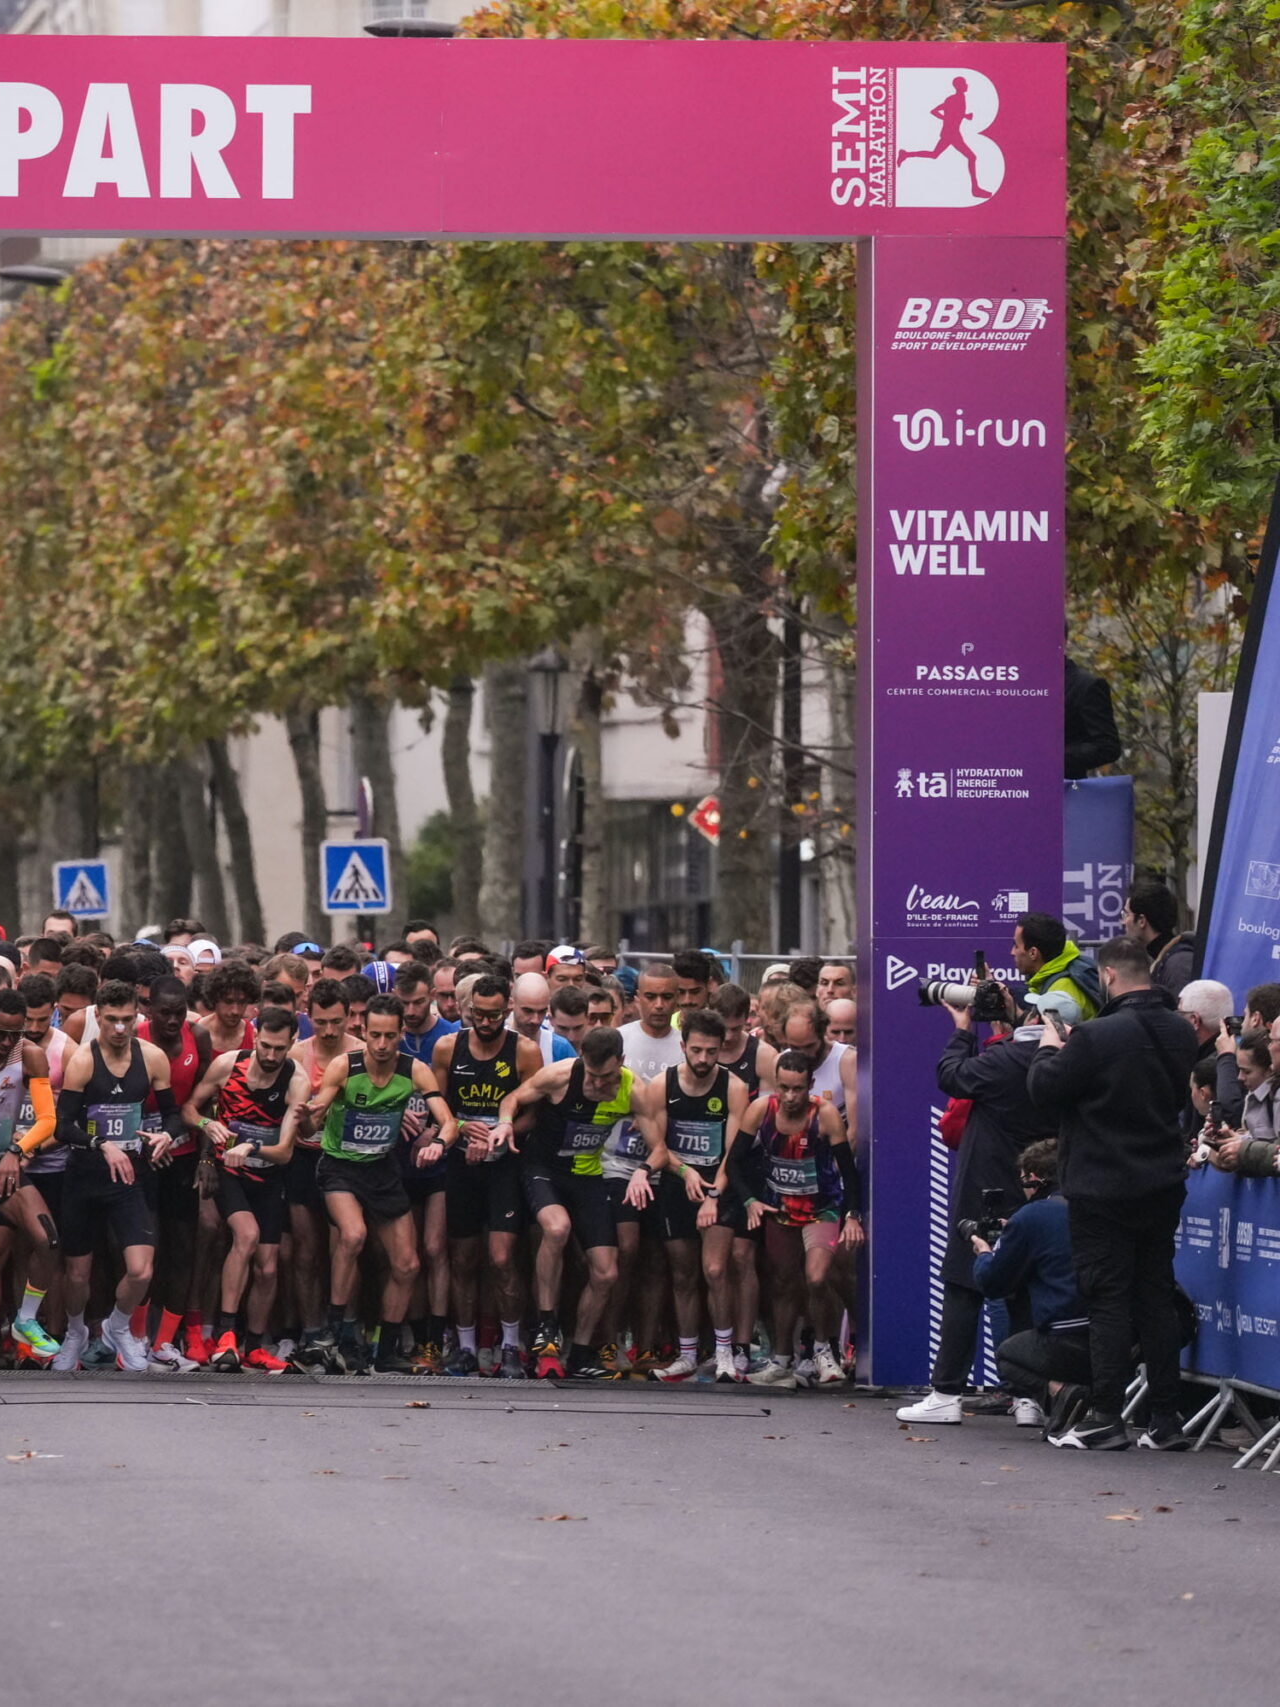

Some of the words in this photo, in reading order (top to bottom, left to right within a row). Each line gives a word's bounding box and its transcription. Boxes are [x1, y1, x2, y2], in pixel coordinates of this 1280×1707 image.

[830, 66, 867, 207] SEMI
[869, 67, 886, 207] MARATHON
[897, 298, 1026, 330] BBSD
[894, 331, 1032, 341] BOULOGNE-BILLANCOURT
[891, 341, 928, 350] SPORT
[930, 340, 1027, 351] DÉVELOPPEMENT
[955, 408, 1046, 447] i-run
[889, 509, 1049, 542] VITAMIN
[889, 544, 986, 576] WELL
[916, 665, 1020, 681] PASSAGES
[886, 688, 923, 696] CENTRE
[927, 688, 1049, 697] COMMERCIAL-BOULOGNE
[956, 768, 1023, 778] HYDRATATION
[956, 779, 998, 788] ENERGIE
[956, 789, 1030, 799] RECUPERATION
[906, 913, 979, 921] D'ILE-DE-FRANCE
[458, 1083, 506, 1100] CAMV
[106, 1119, 124, 1136] 19
[353, 1124, 391, 1140] 6222
[676, 1133, 710, 1152] 7715
[771, 1167, 806, 1184] 4524
